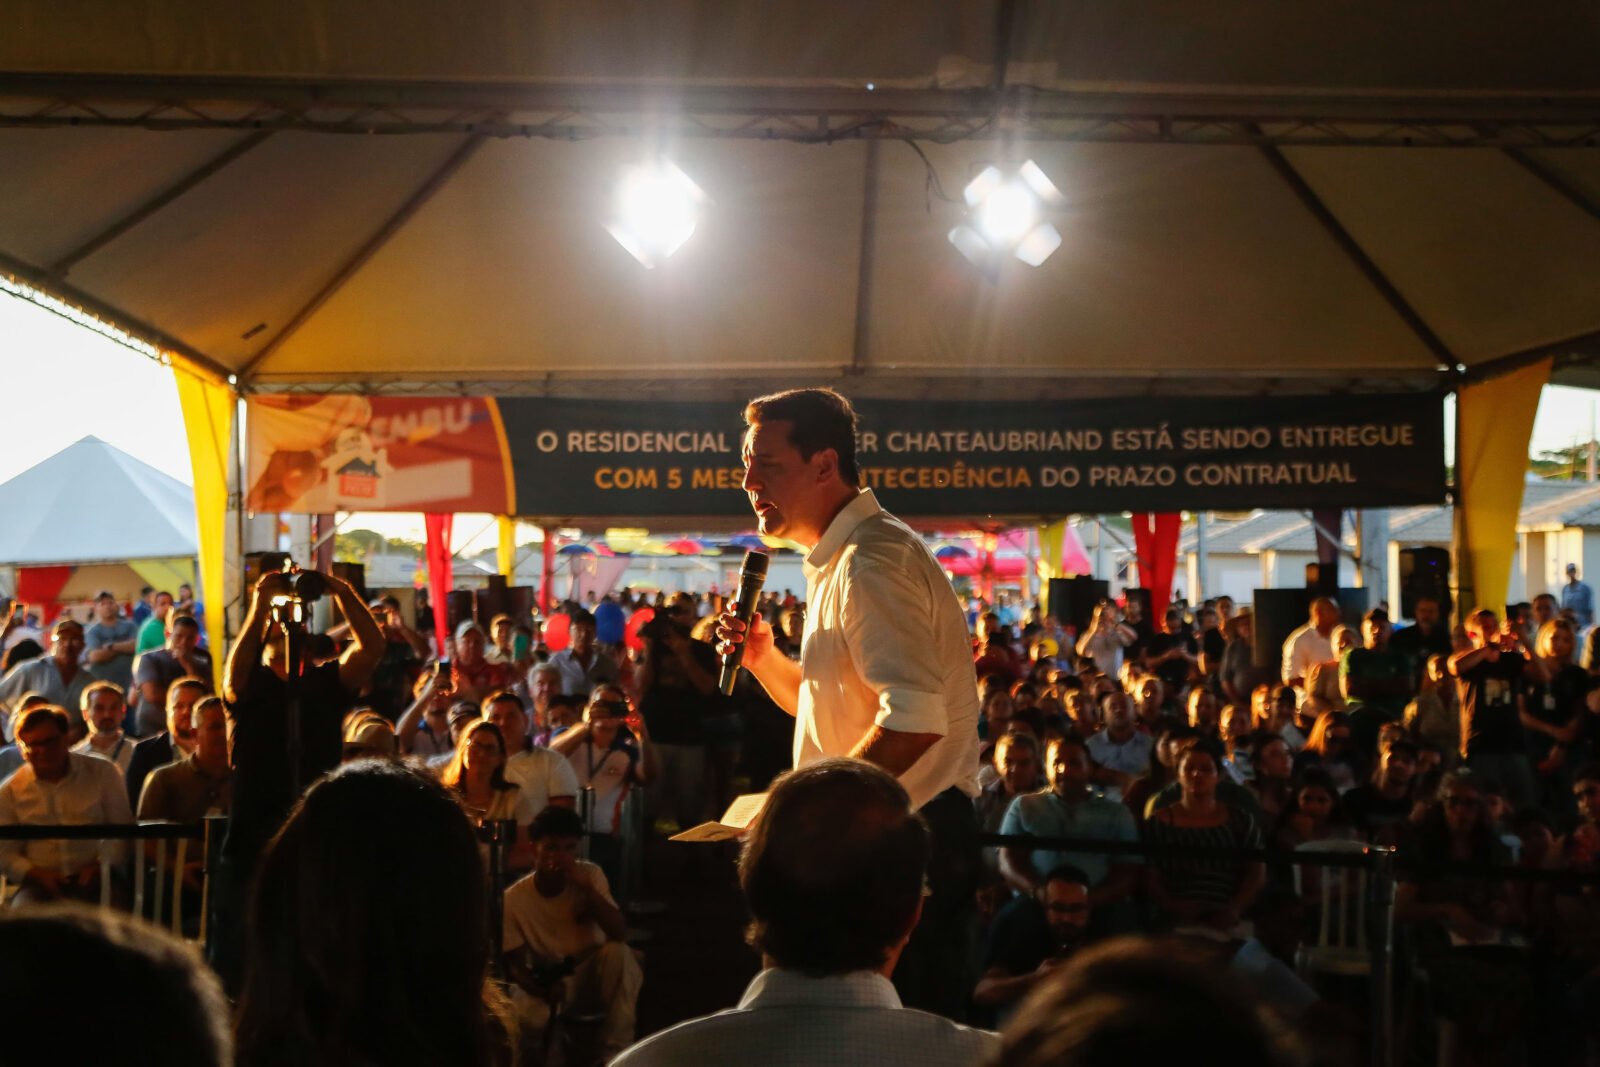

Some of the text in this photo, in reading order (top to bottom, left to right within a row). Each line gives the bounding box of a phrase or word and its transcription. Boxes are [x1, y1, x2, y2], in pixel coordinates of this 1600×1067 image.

[536, 430, 559, 453] O
[567, 430, 731, 453] RESIDENCIAL
[886, 430, 1103, 453] CHATEAUBRIAND
[1111, 422, 1174, 451] ESTÁ
[1183, 427, 1272, 450] SENDO
[1280, 425, 1414, 448] ENTREGUE
[594, 461, 1357, 490] COM 5 MES TECEDÊNCIA DO PRAZO CONTRATUAL
